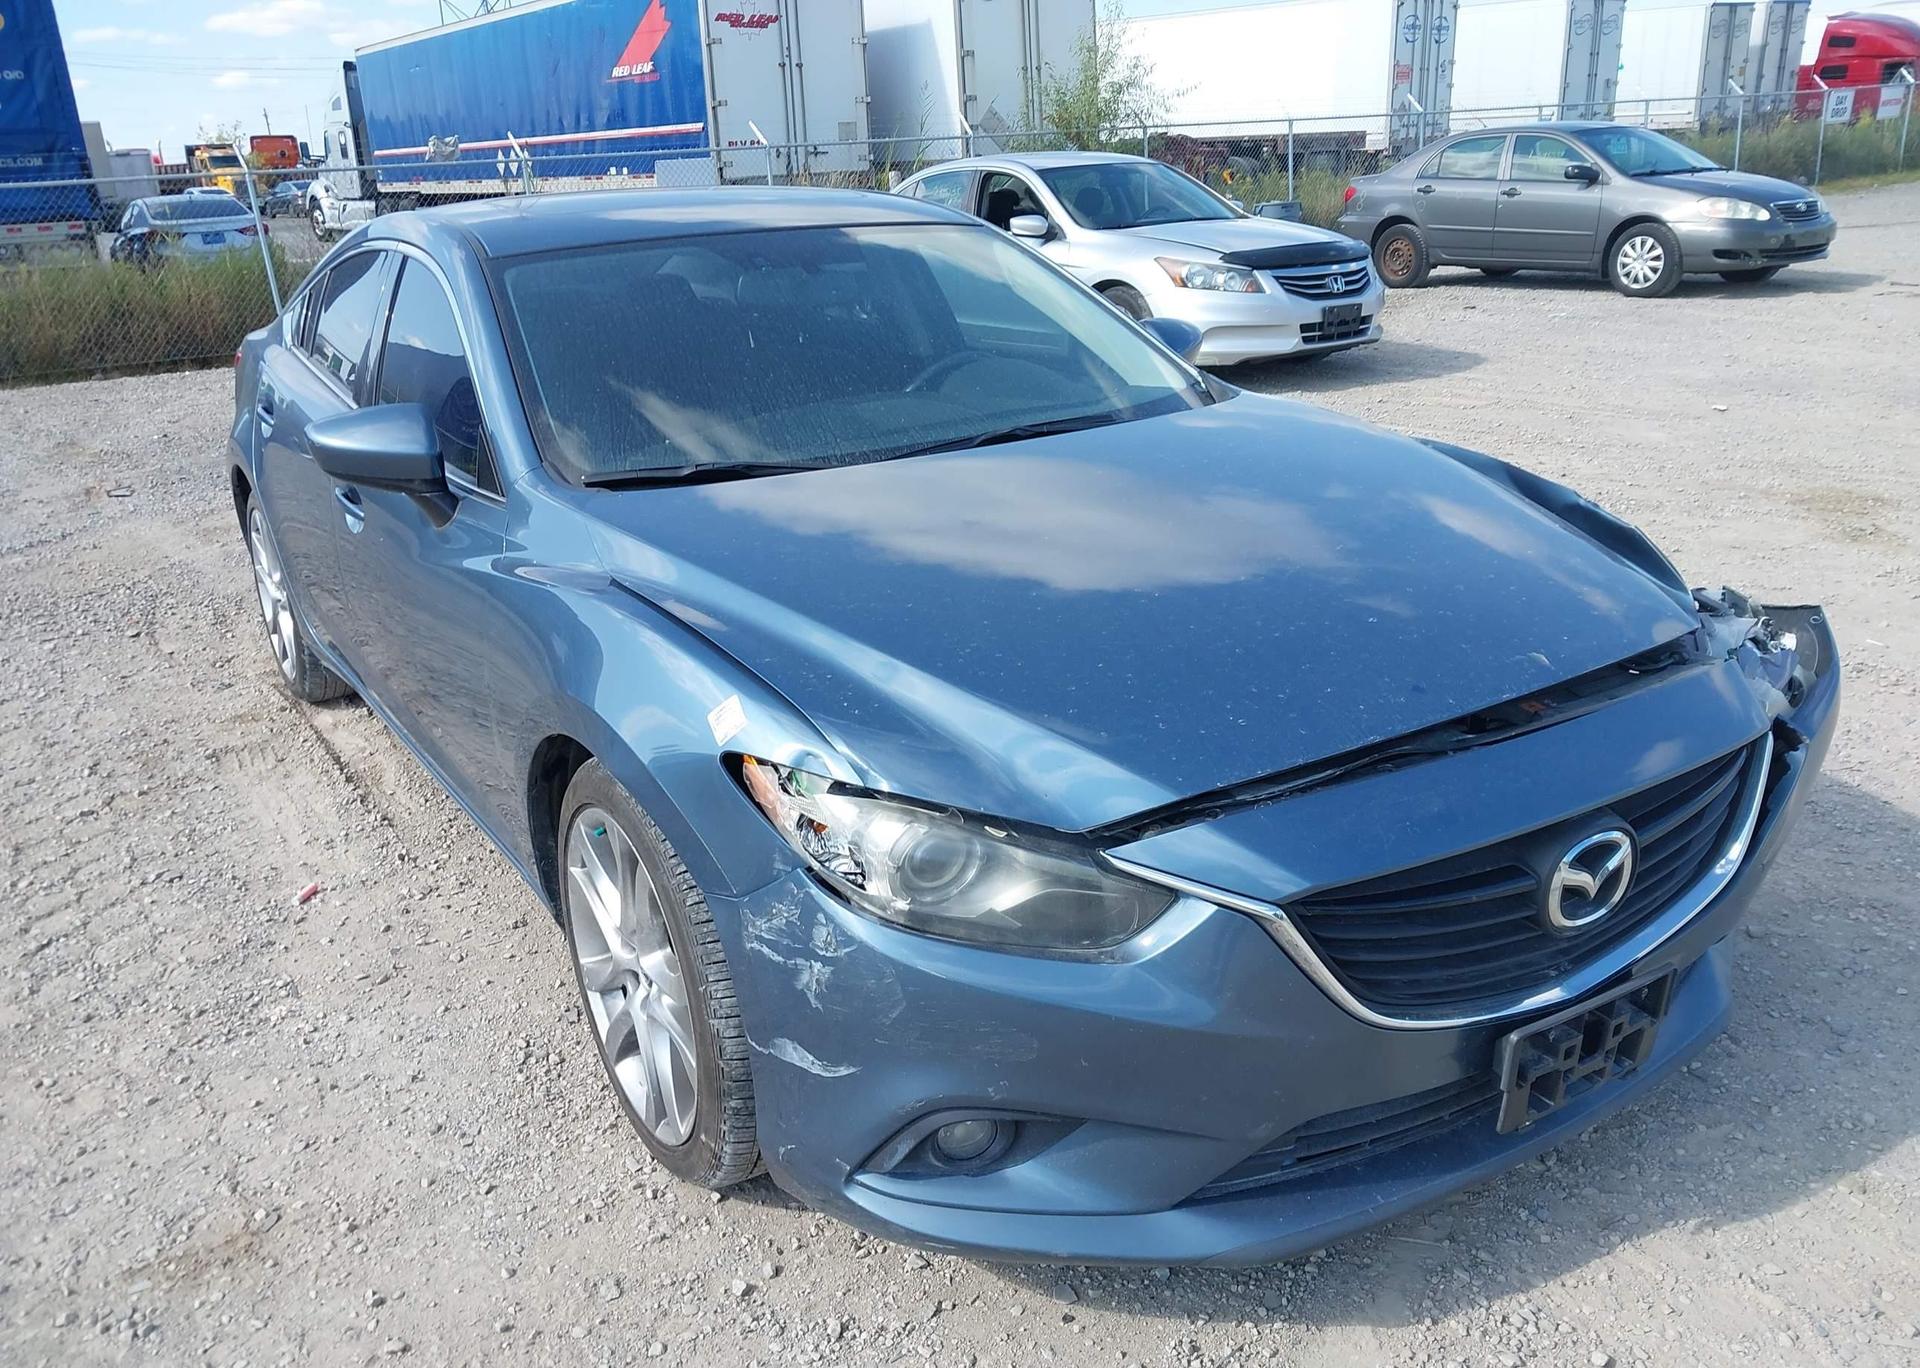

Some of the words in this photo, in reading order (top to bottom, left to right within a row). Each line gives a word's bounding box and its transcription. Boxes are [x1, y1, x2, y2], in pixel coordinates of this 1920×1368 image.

[612, 65, 630, 78] RED
[631, 61, 655, 75] LEAF
[1836, 95, 1848, 106] DAY
[1831, 107, 1848, 118] DROP
